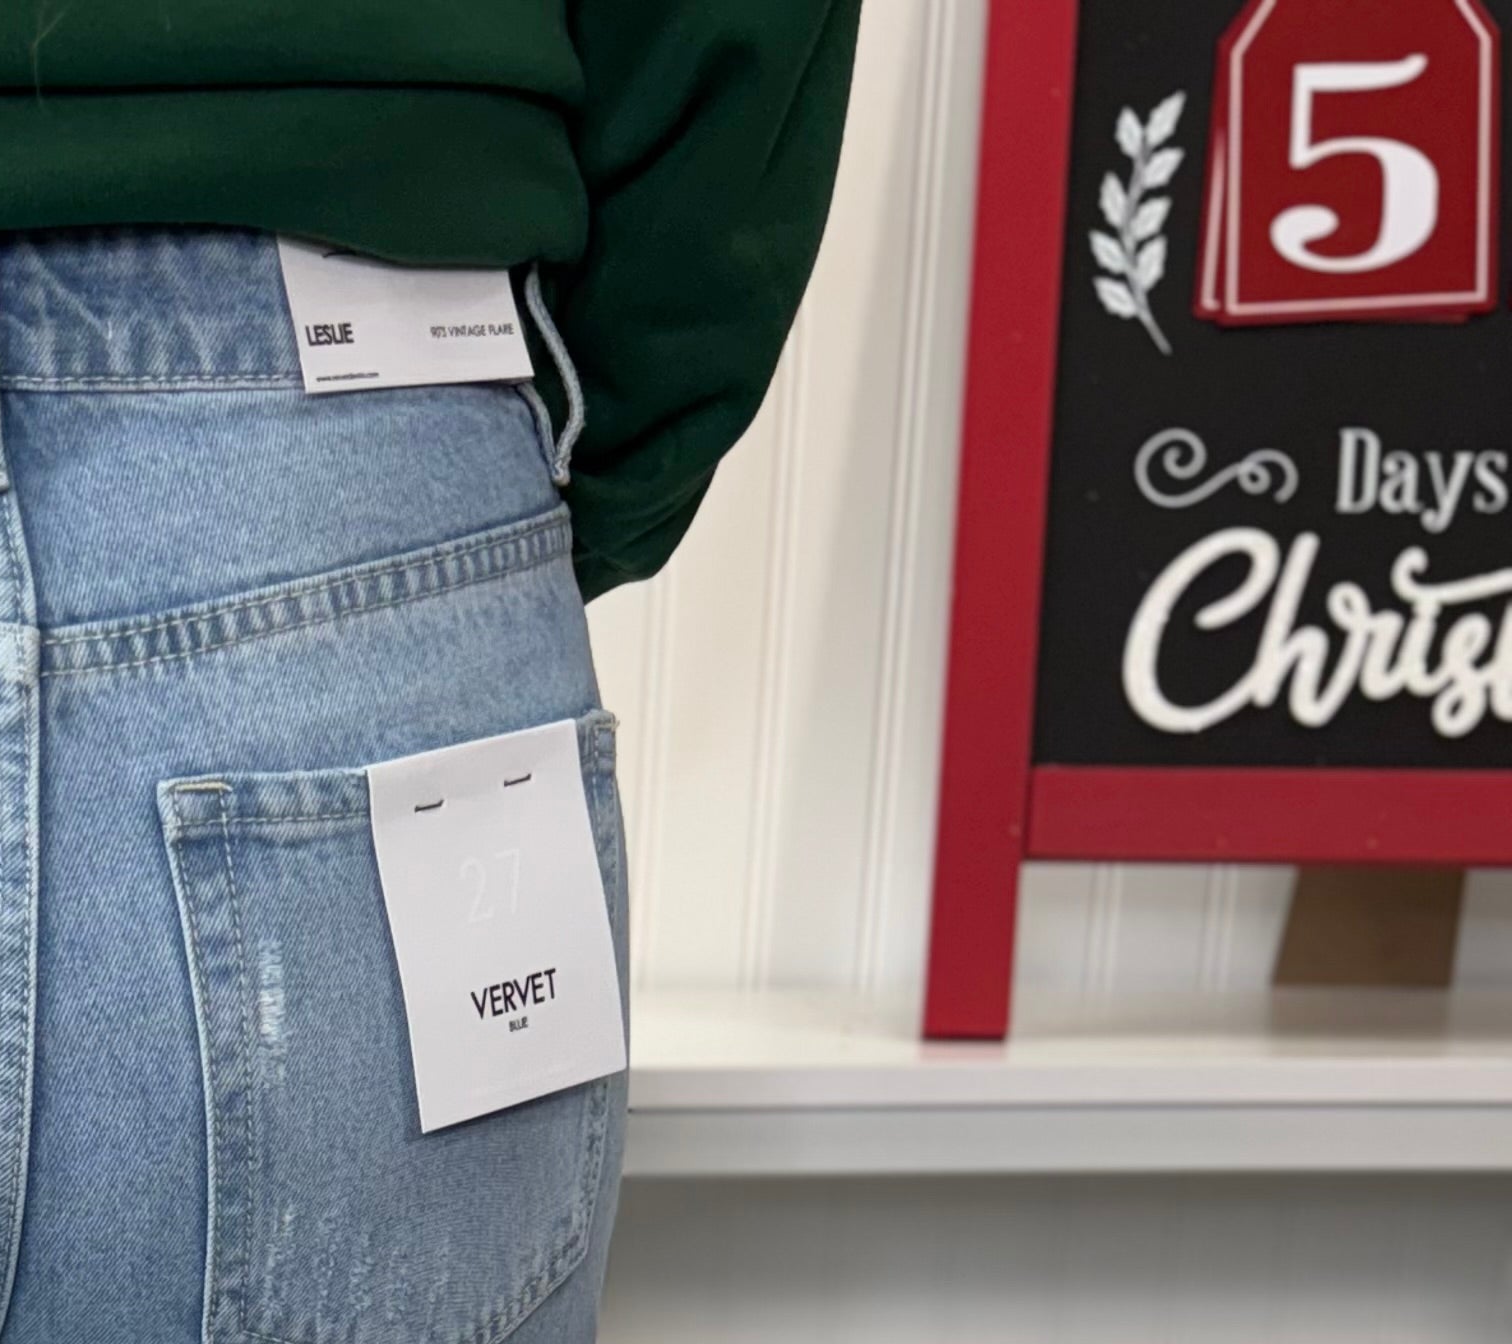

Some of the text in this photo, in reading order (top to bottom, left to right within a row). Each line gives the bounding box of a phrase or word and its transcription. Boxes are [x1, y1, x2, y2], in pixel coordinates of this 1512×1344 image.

[1269, 53, 1440, 273] 5
[305, 322, 355, 347] LESLIE
[448, 324, 487, 337] VINTAGE
[1336, 427, 1508, 533] Days
[459, 848, 521, 923] 27
[470, 967, 556, 1020] VERVET
[509, 1016, 529, 1032] BLUE
